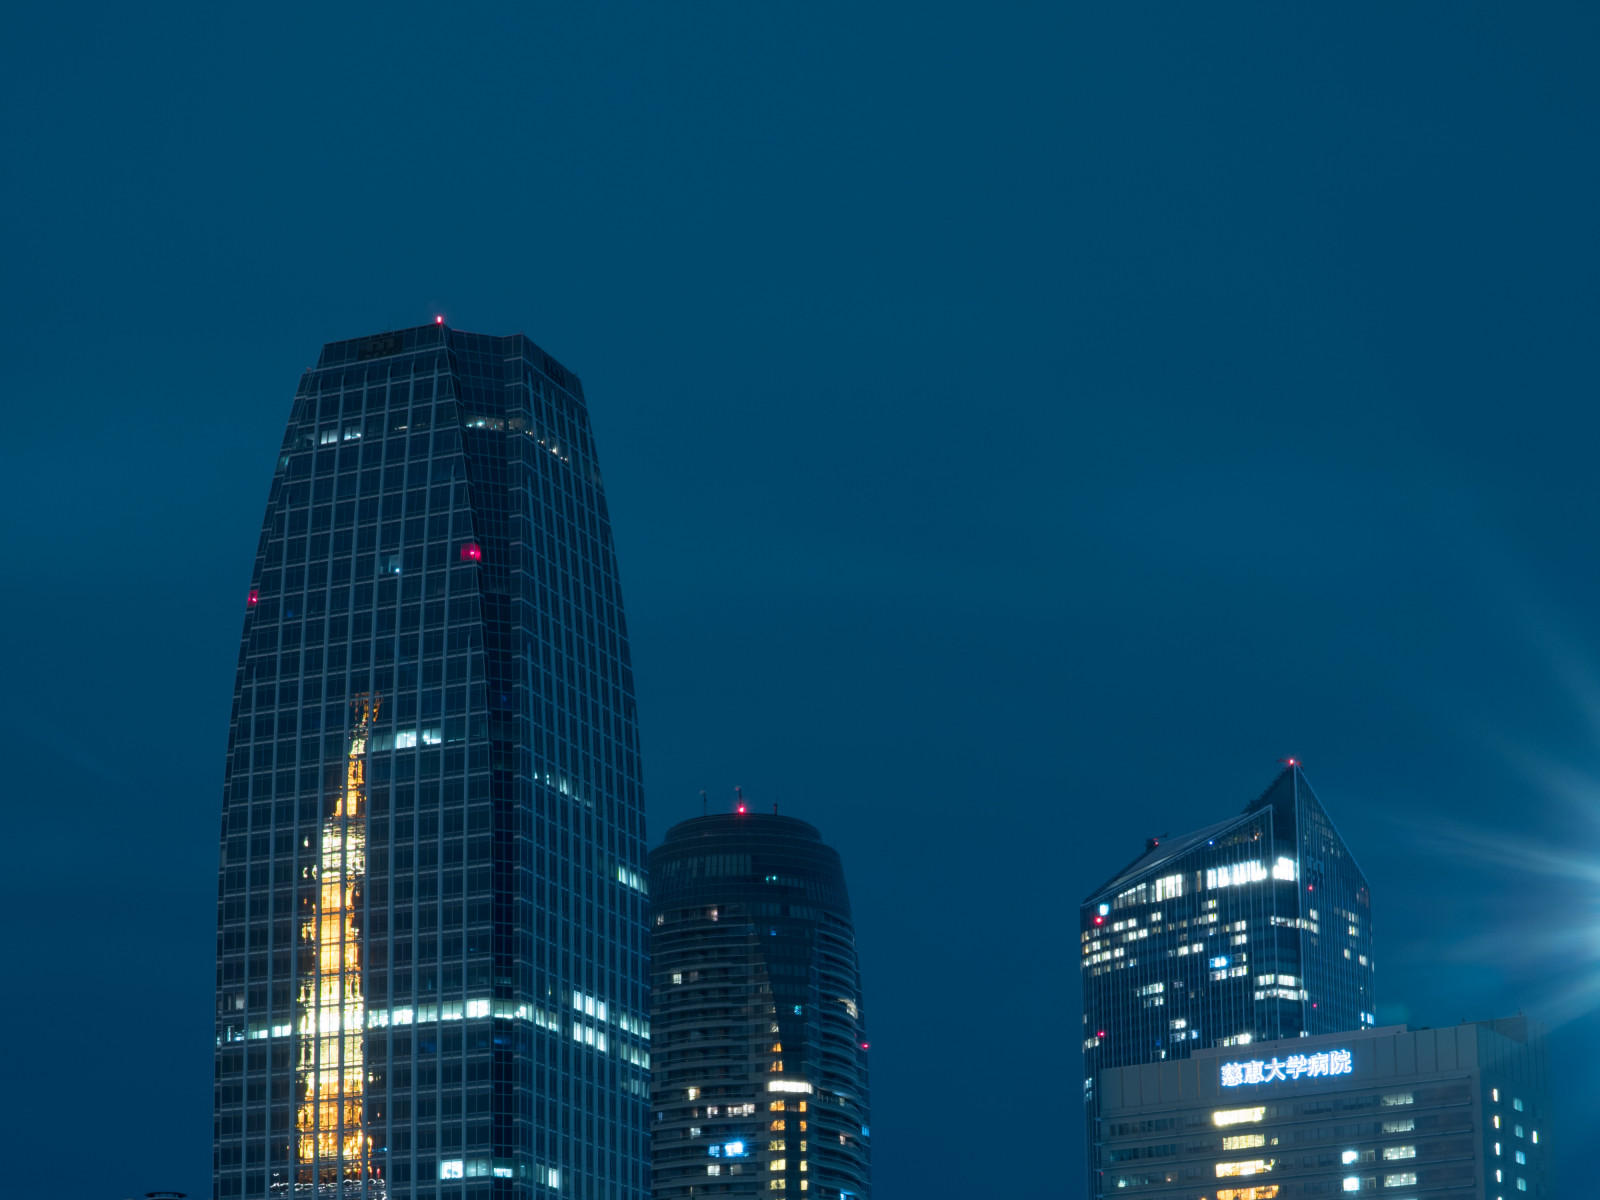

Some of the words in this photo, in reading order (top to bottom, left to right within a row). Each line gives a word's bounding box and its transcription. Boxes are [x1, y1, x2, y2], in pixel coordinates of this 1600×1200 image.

[1220, 1049, 1352, 1087] 慈恵大学病院
